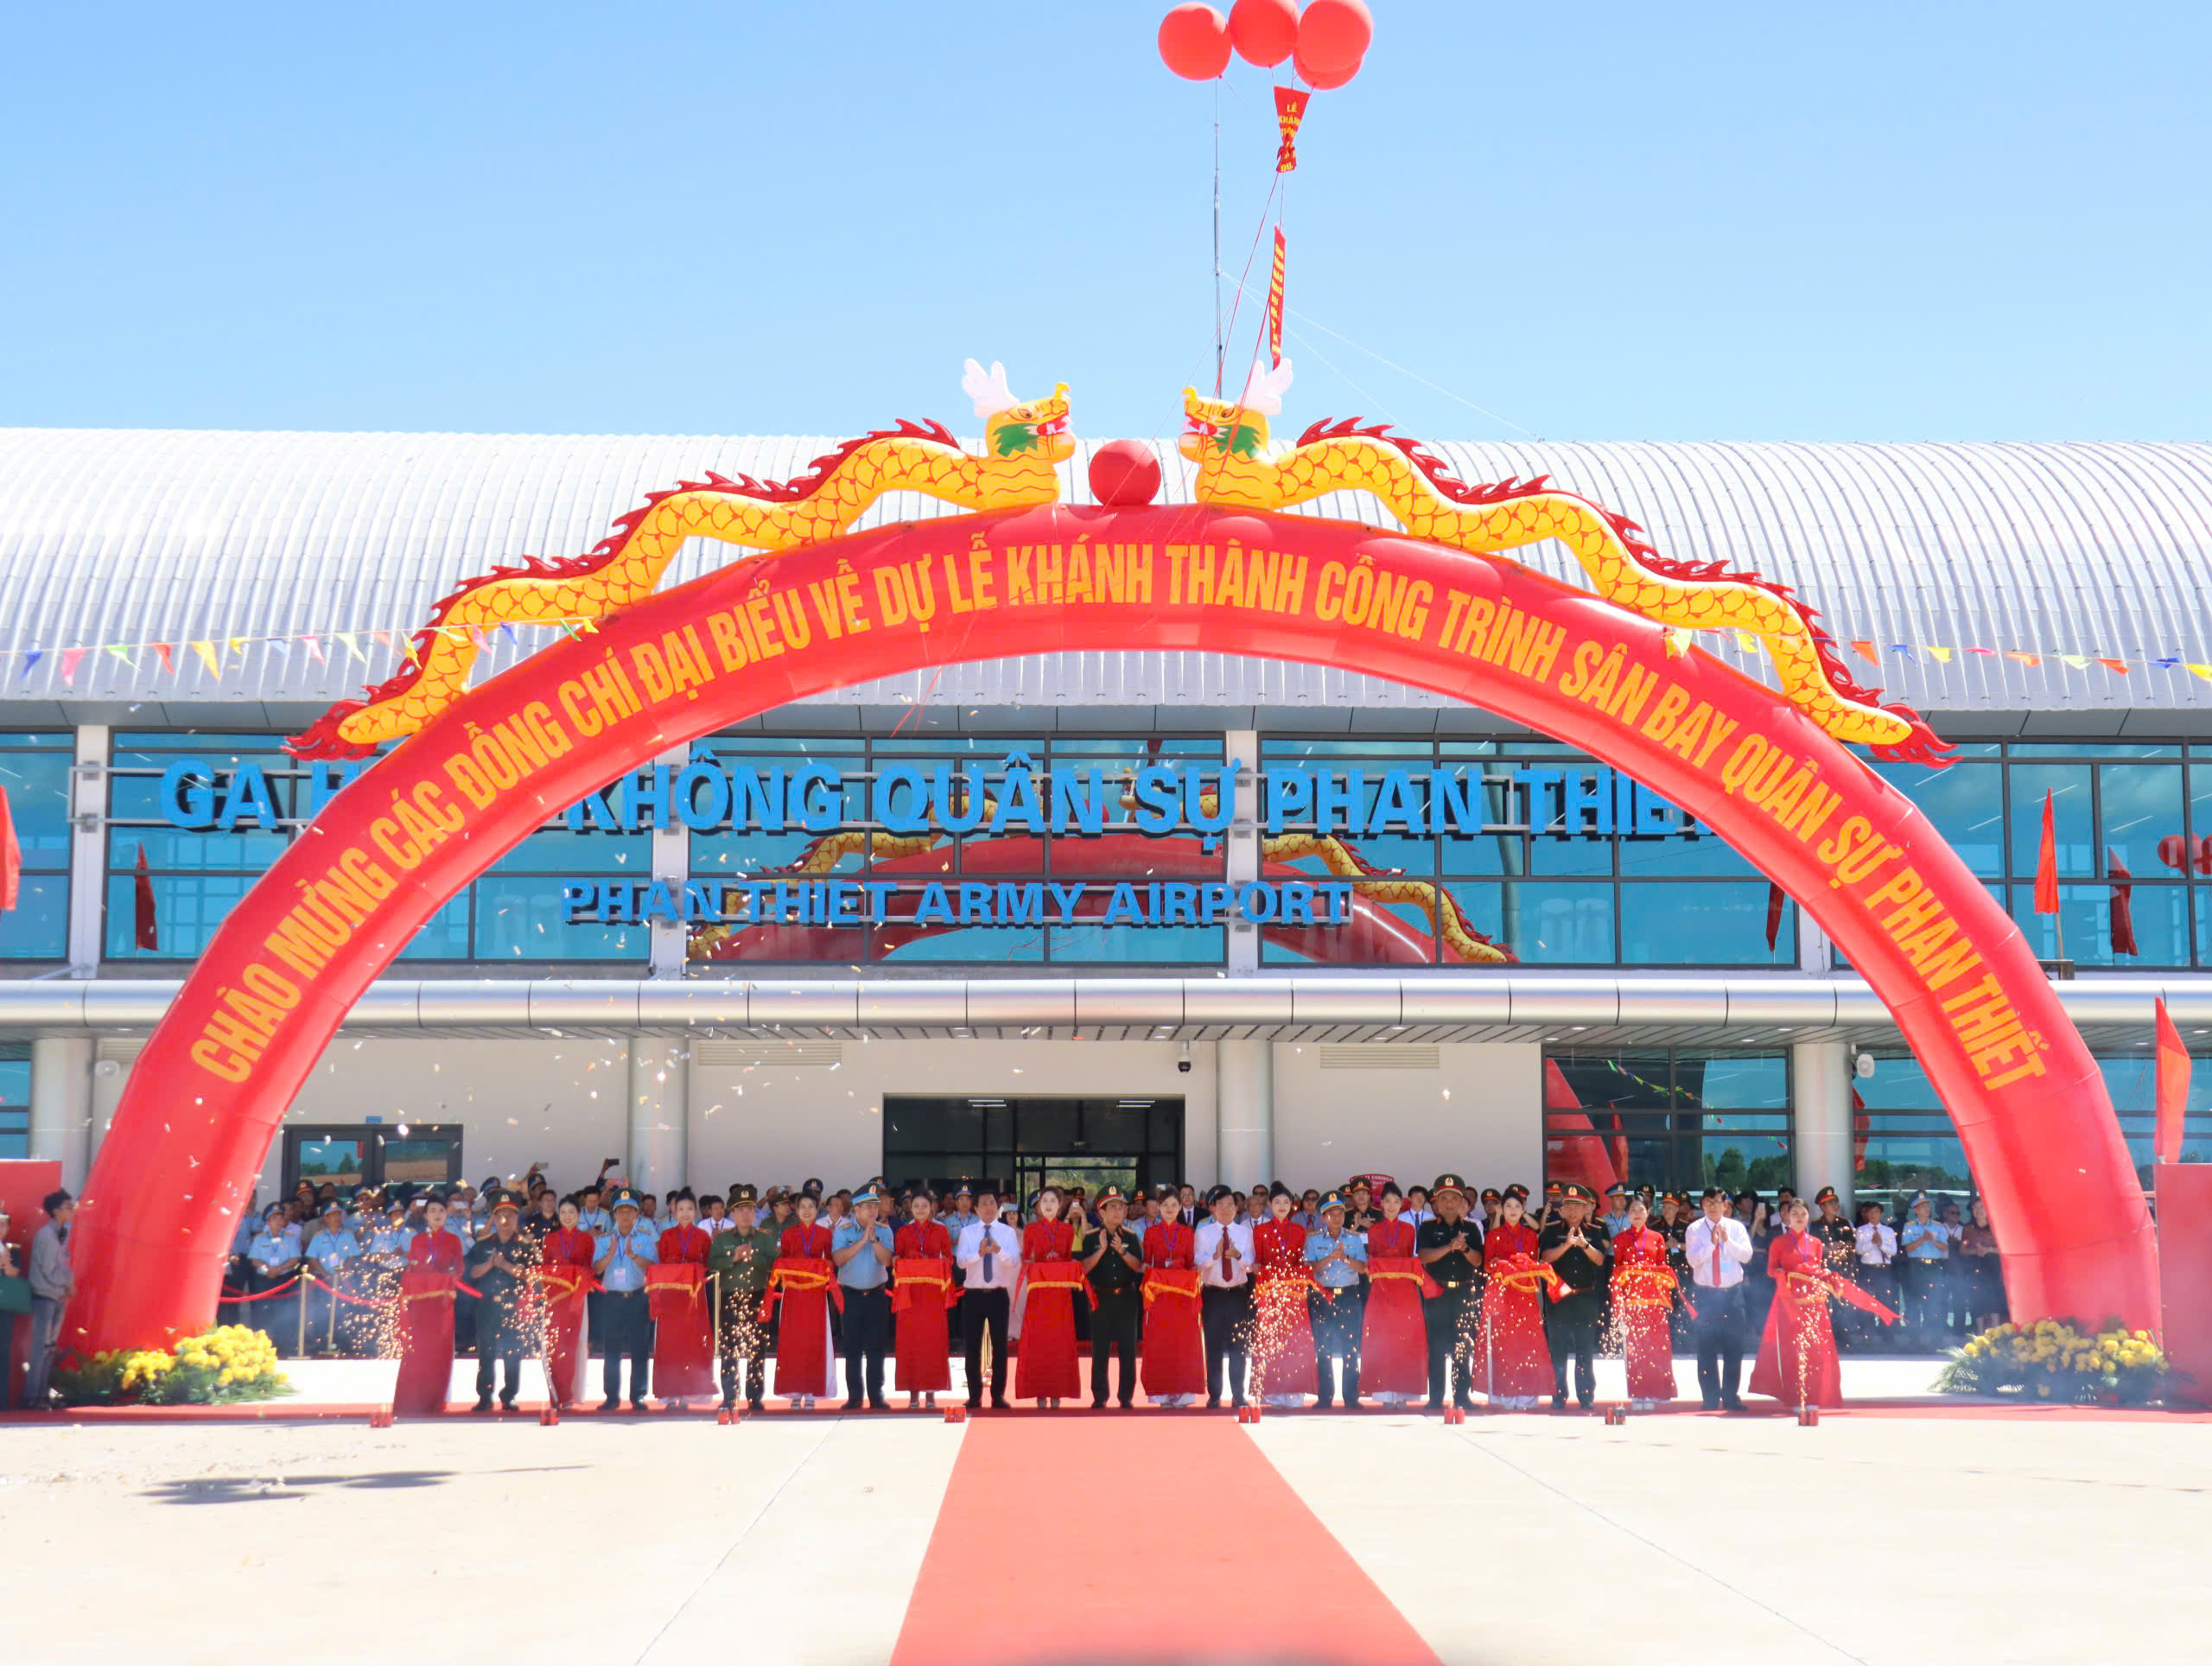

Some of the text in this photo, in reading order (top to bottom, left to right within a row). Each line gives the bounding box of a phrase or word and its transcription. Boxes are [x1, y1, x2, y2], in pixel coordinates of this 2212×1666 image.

[159, 760, 277, 829] GA
[874, 750, 1103, 834] QUÂN
[1135, 758, 1242, 851] SỰ
[1267, 768, 1482, 835] PHAN
[191, 963, 302, 1084] CHÀO
[264, 848, 399, 981] MỪNG
[370, 779, 467, 870] CÁC
[442, 701, 574, 811] ĐỒNG
[558, 648, 644, 738] CHÍ
[629, 623, 716, 700] ĐẠI
[707, 578, 811, 673] BIỂU
[808, 557, 871, 640] VỀ
[873, 552, 937, 633] DỰ
[944, 531, 998, 615] LỄ
[1006, 533, 1154, 607] KHÁNH
[1165, 537, 1308, 615] THÀNH
[1314, 553, 1434, 642] CÔNG
[1437, 588, 1567, 684] TRÌNH
[1558, 642, 1659, 727] SÂN
[1639, 684, 1739, 769] BAY
[1721, 733, 1843, 843] QUÂN
[1817, 815, 1906, 889] SỰ
[1864, 867, 1984, 991] PHAN
[1940, 972, 2050, 1091] THIẾT
[562, 881, 1354, 925] PHAN THIET ARMY AIRPORT
